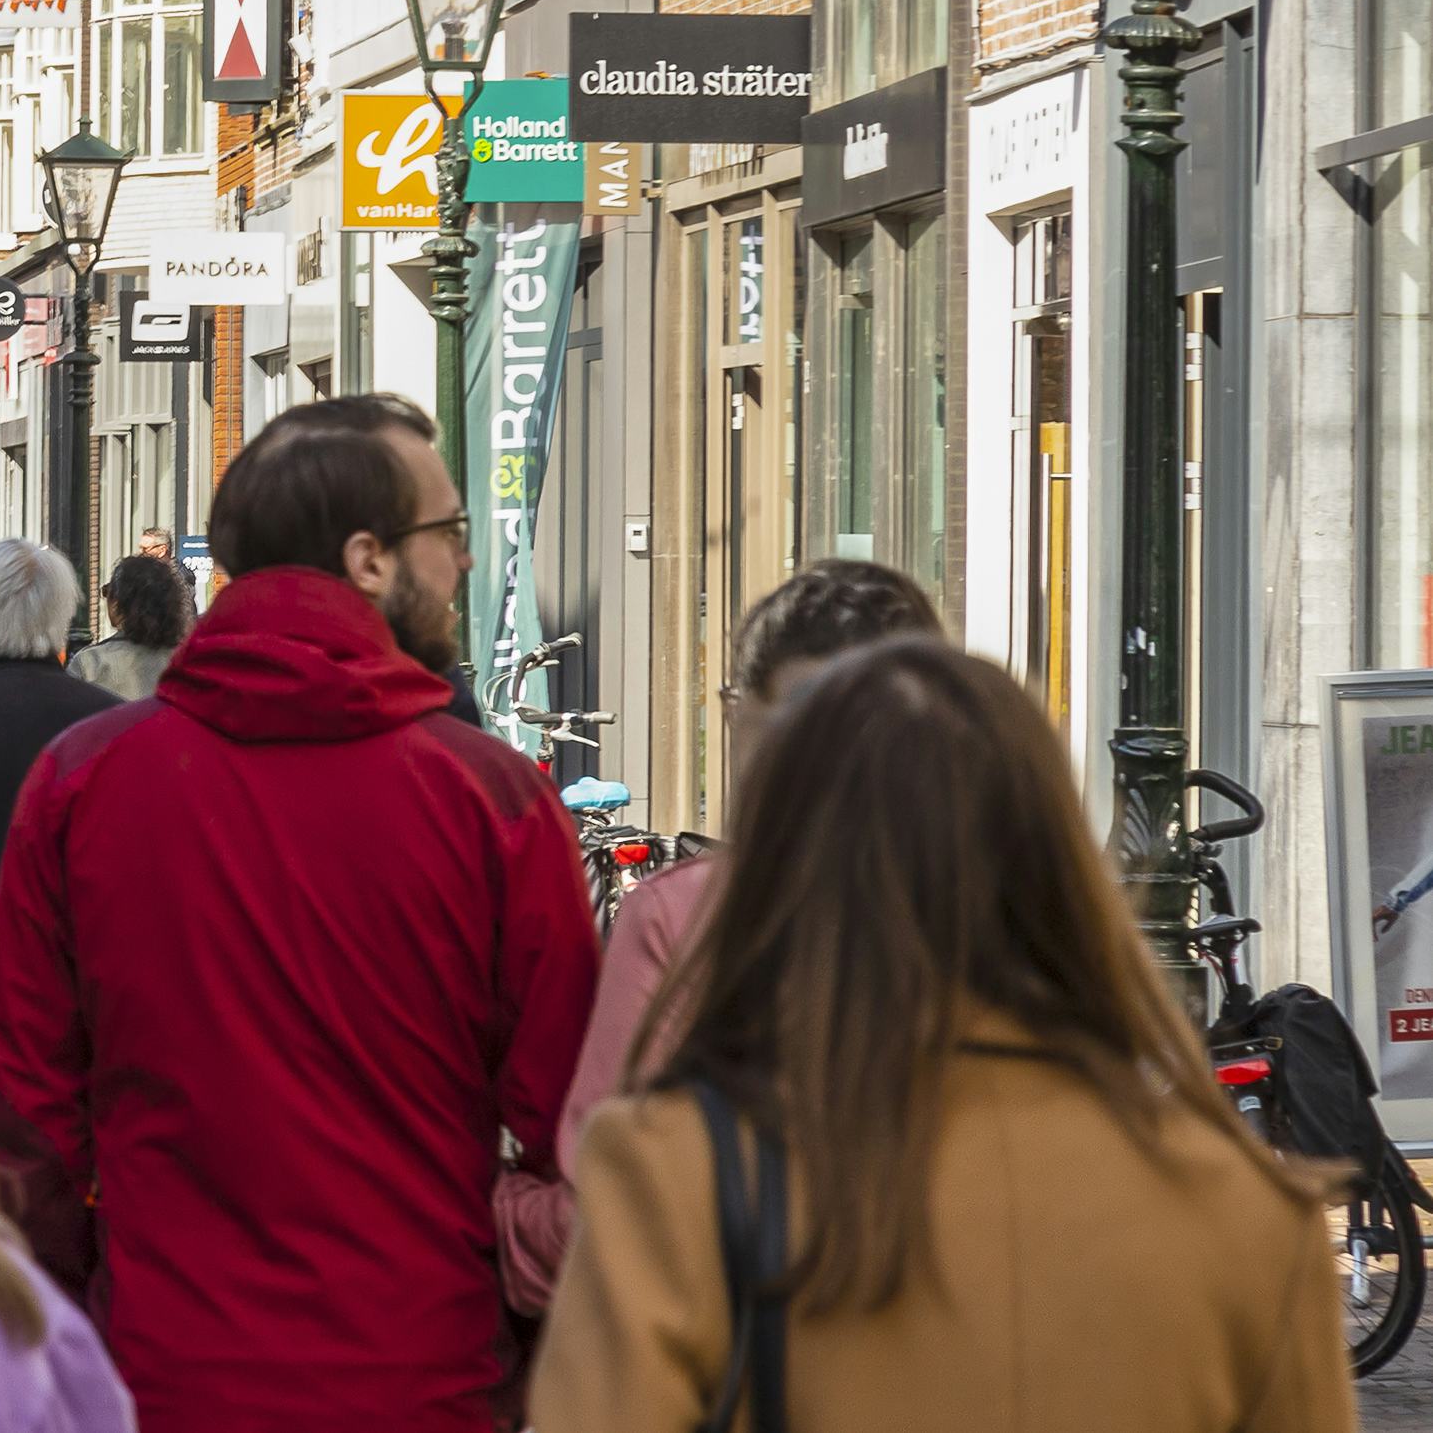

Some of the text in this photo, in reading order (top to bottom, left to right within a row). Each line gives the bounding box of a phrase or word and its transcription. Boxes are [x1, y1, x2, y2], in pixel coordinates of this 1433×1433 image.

[579, 60, 812, 98] claudia sträter
[472, 116, 566, 139] Holland
[491, 218, 547, 451] Barrett
[1396, 1017, 1433, 1033] 2 JE
